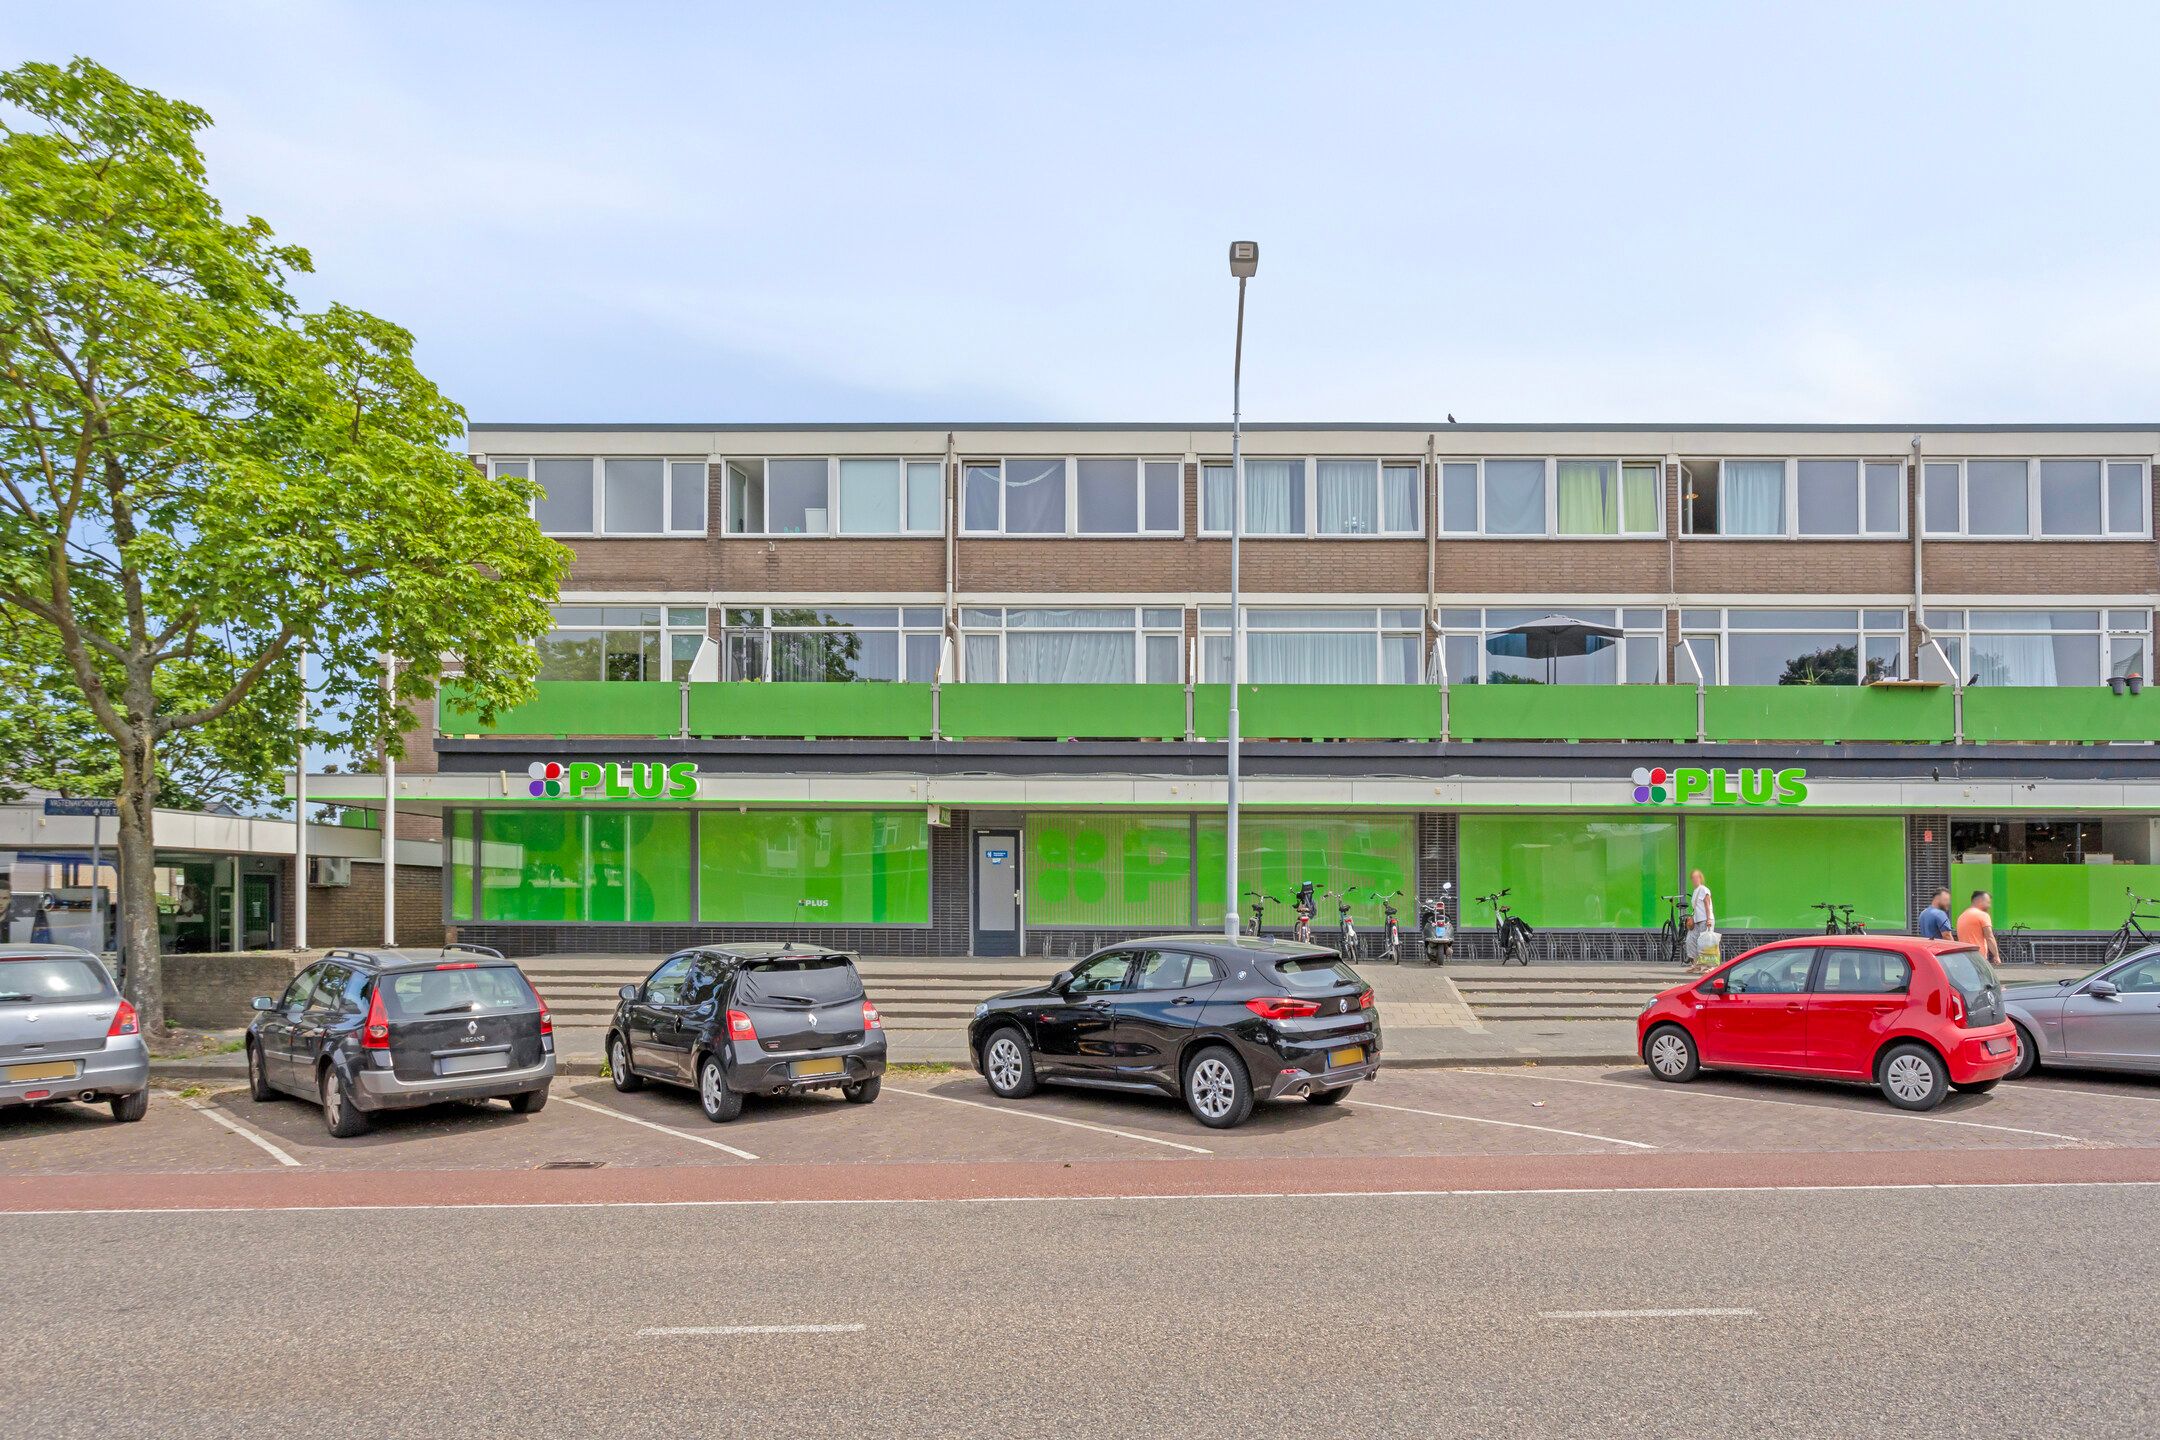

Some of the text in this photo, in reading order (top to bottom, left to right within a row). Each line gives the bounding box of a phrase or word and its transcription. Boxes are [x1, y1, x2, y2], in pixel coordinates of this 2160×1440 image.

[569, 762, 698, 798] PLUS
[1674, 767, 1808, 804] PLUS
[805, 899, 828, 907] PLUS
